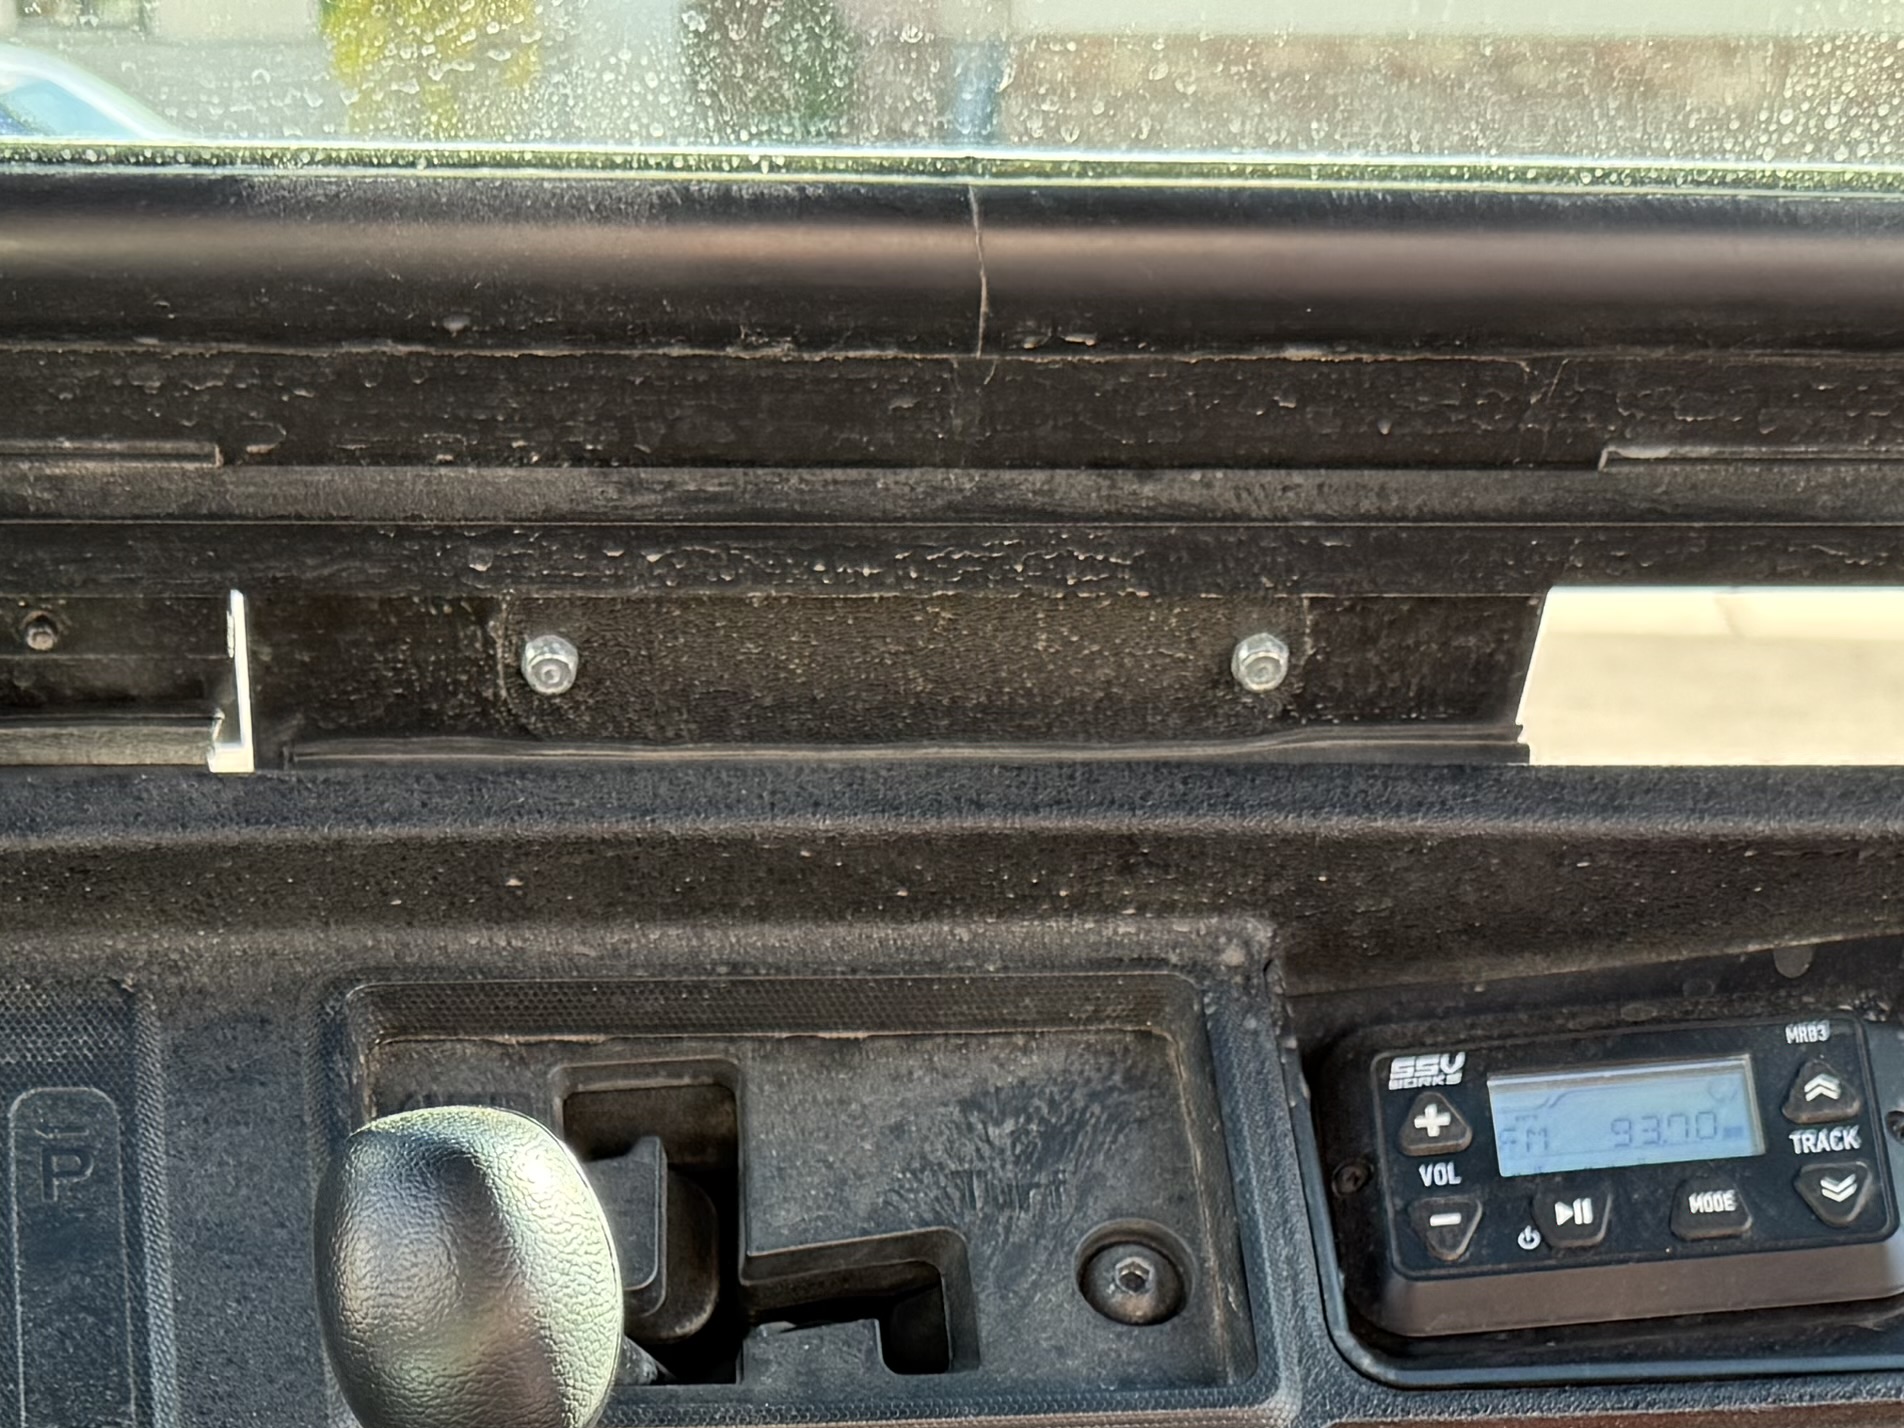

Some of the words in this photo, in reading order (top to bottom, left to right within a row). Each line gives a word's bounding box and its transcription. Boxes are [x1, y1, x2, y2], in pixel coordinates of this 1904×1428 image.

[1390, 1052, 1465, 1079] SSV
[1789, 1125, 1861, 1154] TRACK
[42, 1146, 95, 1201] P
[1419, 1161, 1462, 1187] VOL
[1689, 1190, 1737, 1214] MODE
